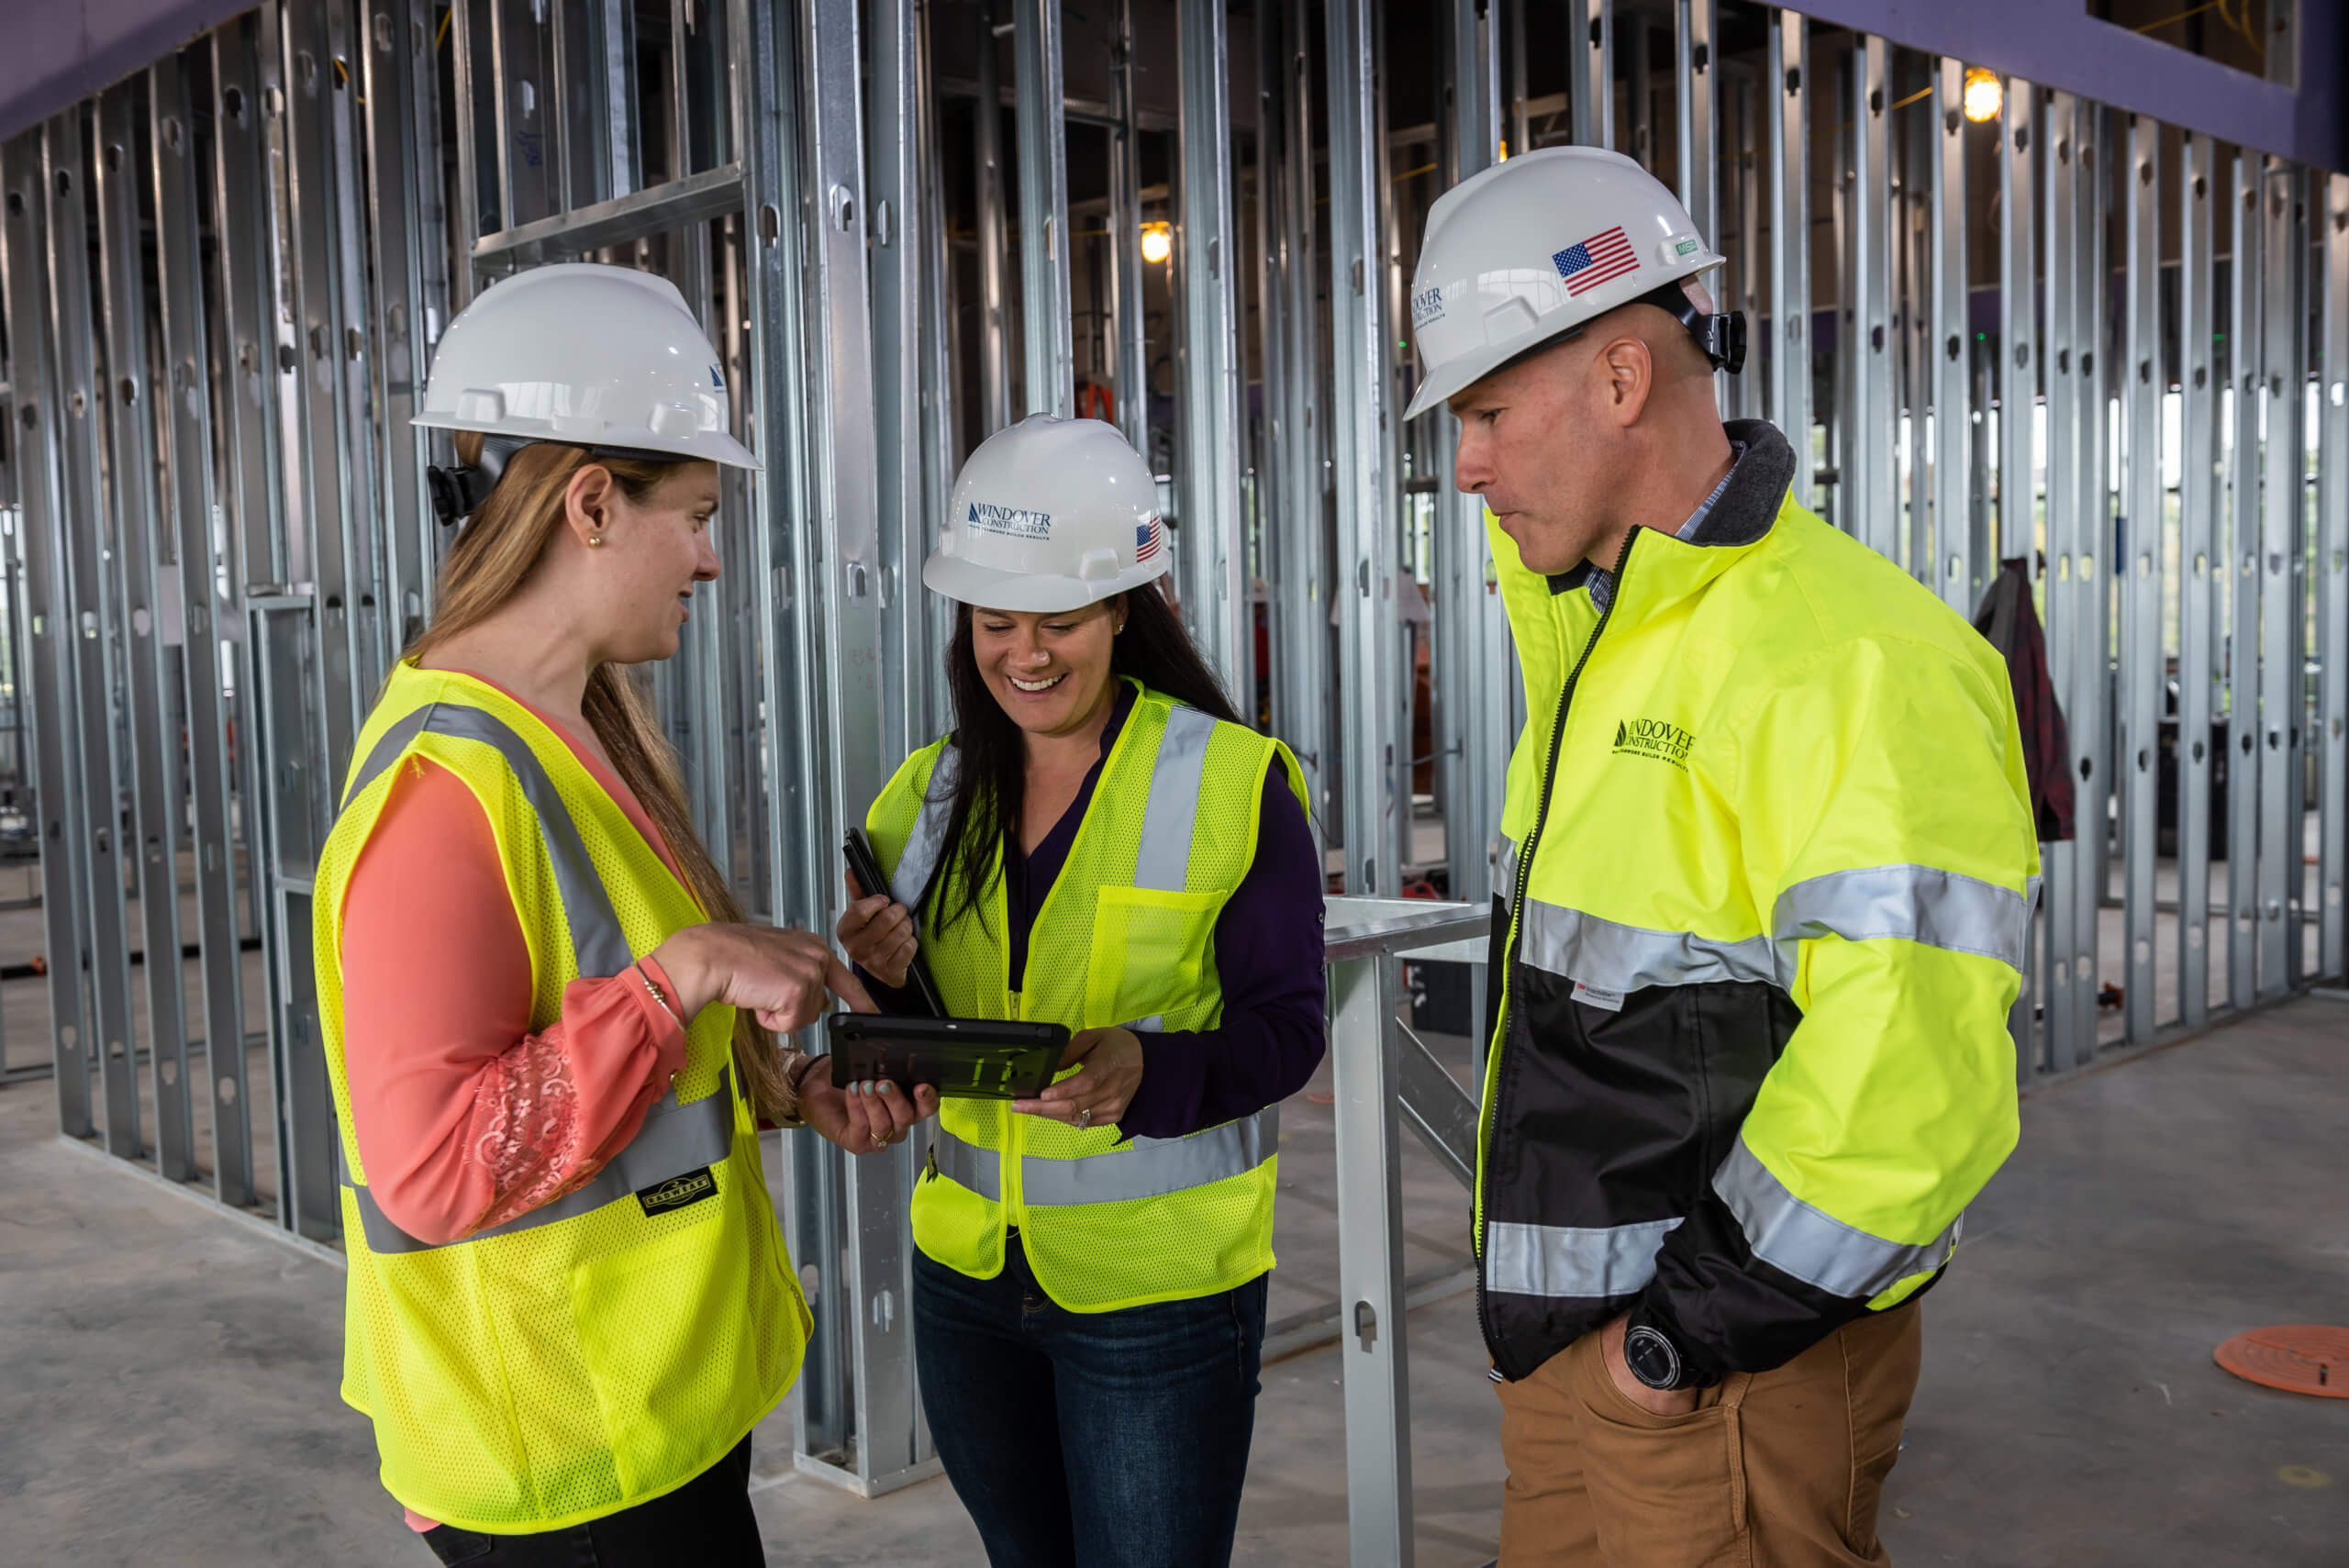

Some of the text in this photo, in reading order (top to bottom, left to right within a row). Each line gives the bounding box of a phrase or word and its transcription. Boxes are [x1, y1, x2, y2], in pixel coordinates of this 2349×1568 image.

[1413, 287, 1442, 311] DOVER
[977, 502, 1051, 527] WINDOVER
[982, 517, 1050, 535] CONSTRUCTION
[1630, 718, 1696, 751] NDOVE
[1628, 735, 1688, 761] NSTRUCTIO
